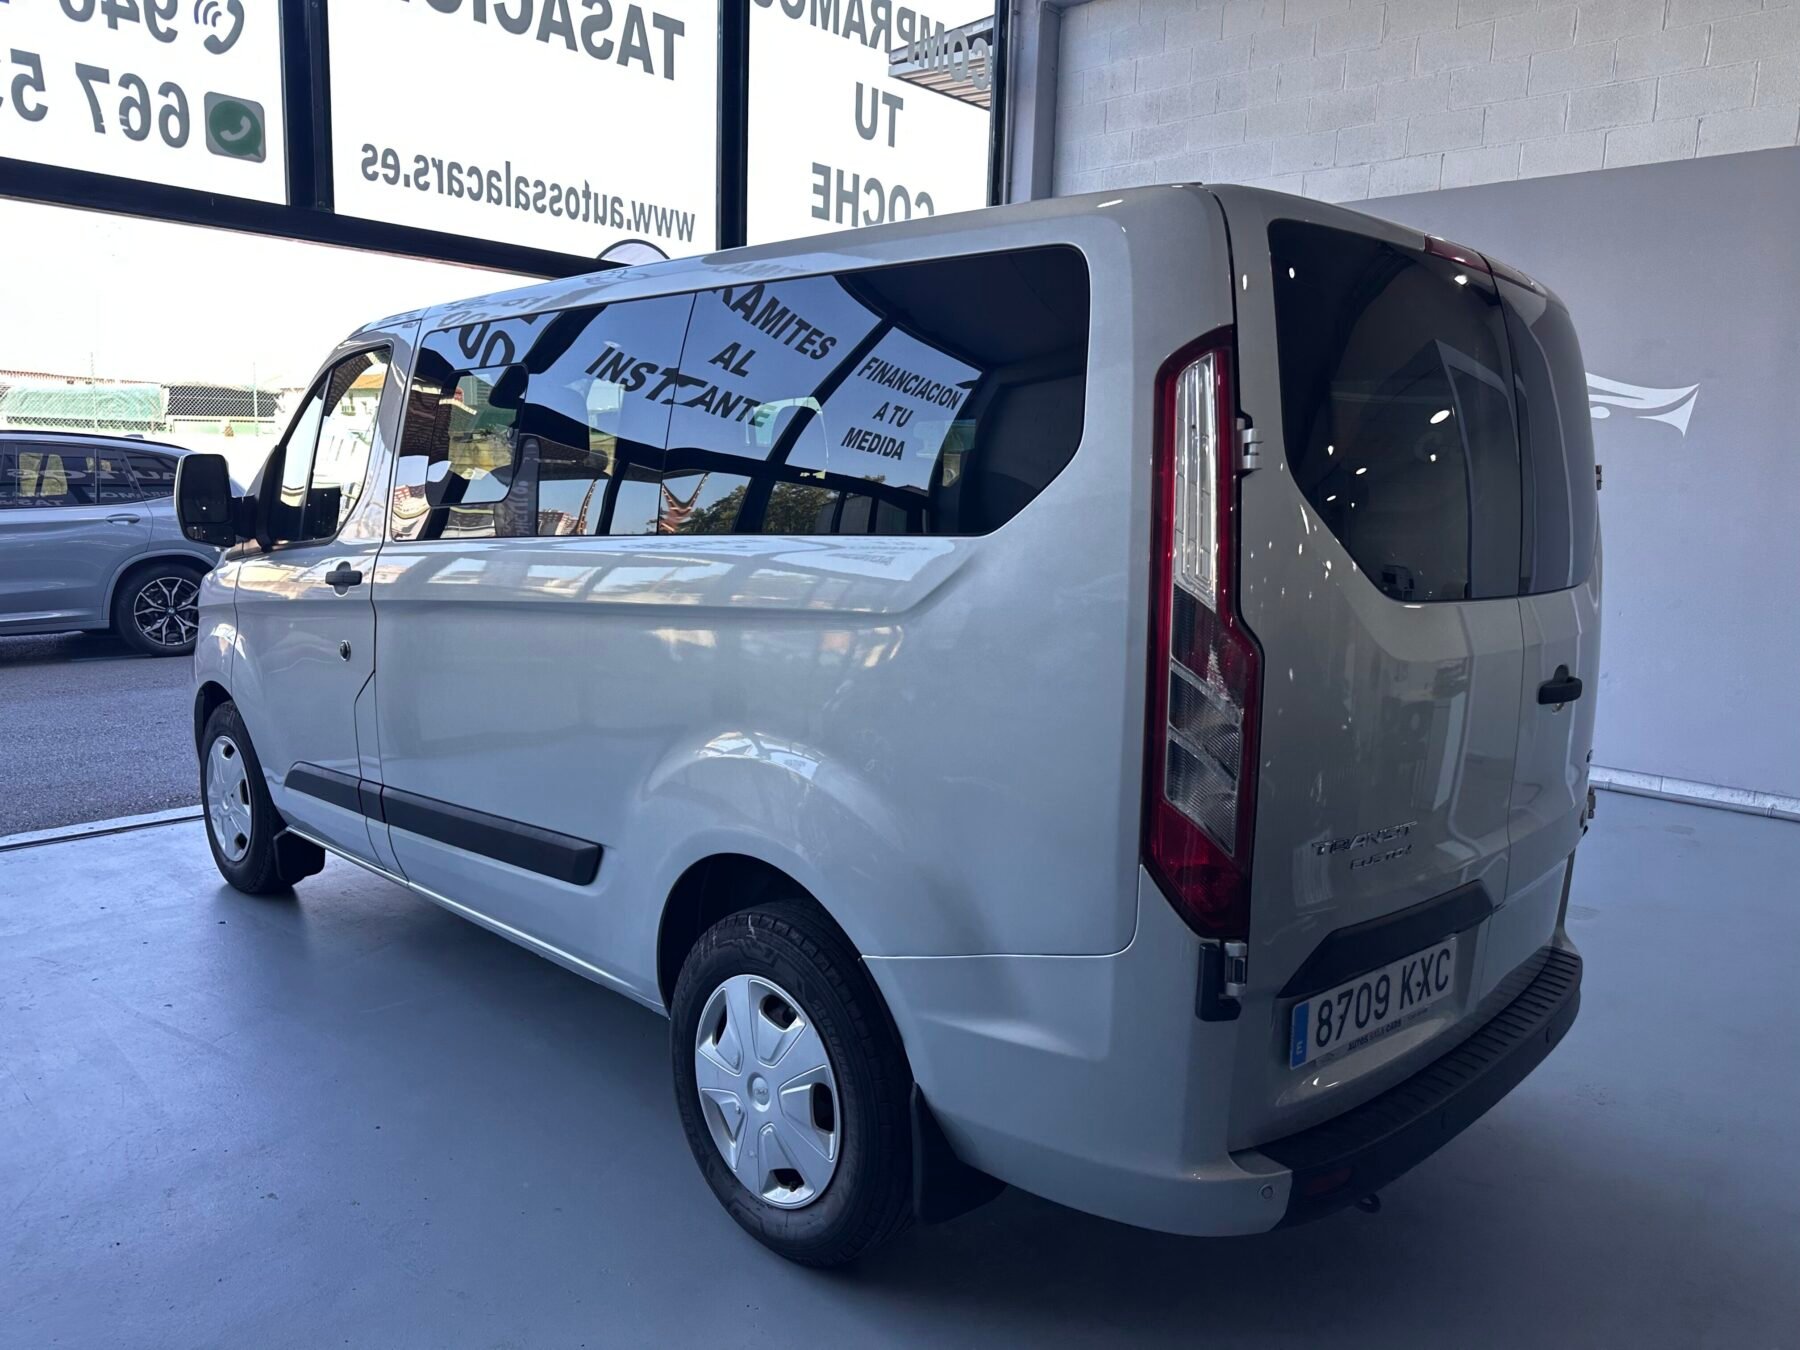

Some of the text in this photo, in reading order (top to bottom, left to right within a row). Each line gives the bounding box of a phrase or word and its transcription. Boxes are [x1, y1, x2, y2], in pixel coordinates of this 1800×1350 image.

[713, 284, 837, 360] AMITES
[708, 342, 756, 378] AL
[857, 357, 962, 410] FINANCIACION
[873, 402, 914, 427] A TU
[841, 426, 906, 461] MEDIDA
[1315, 948, 1451, 1048] 8709 KXC
